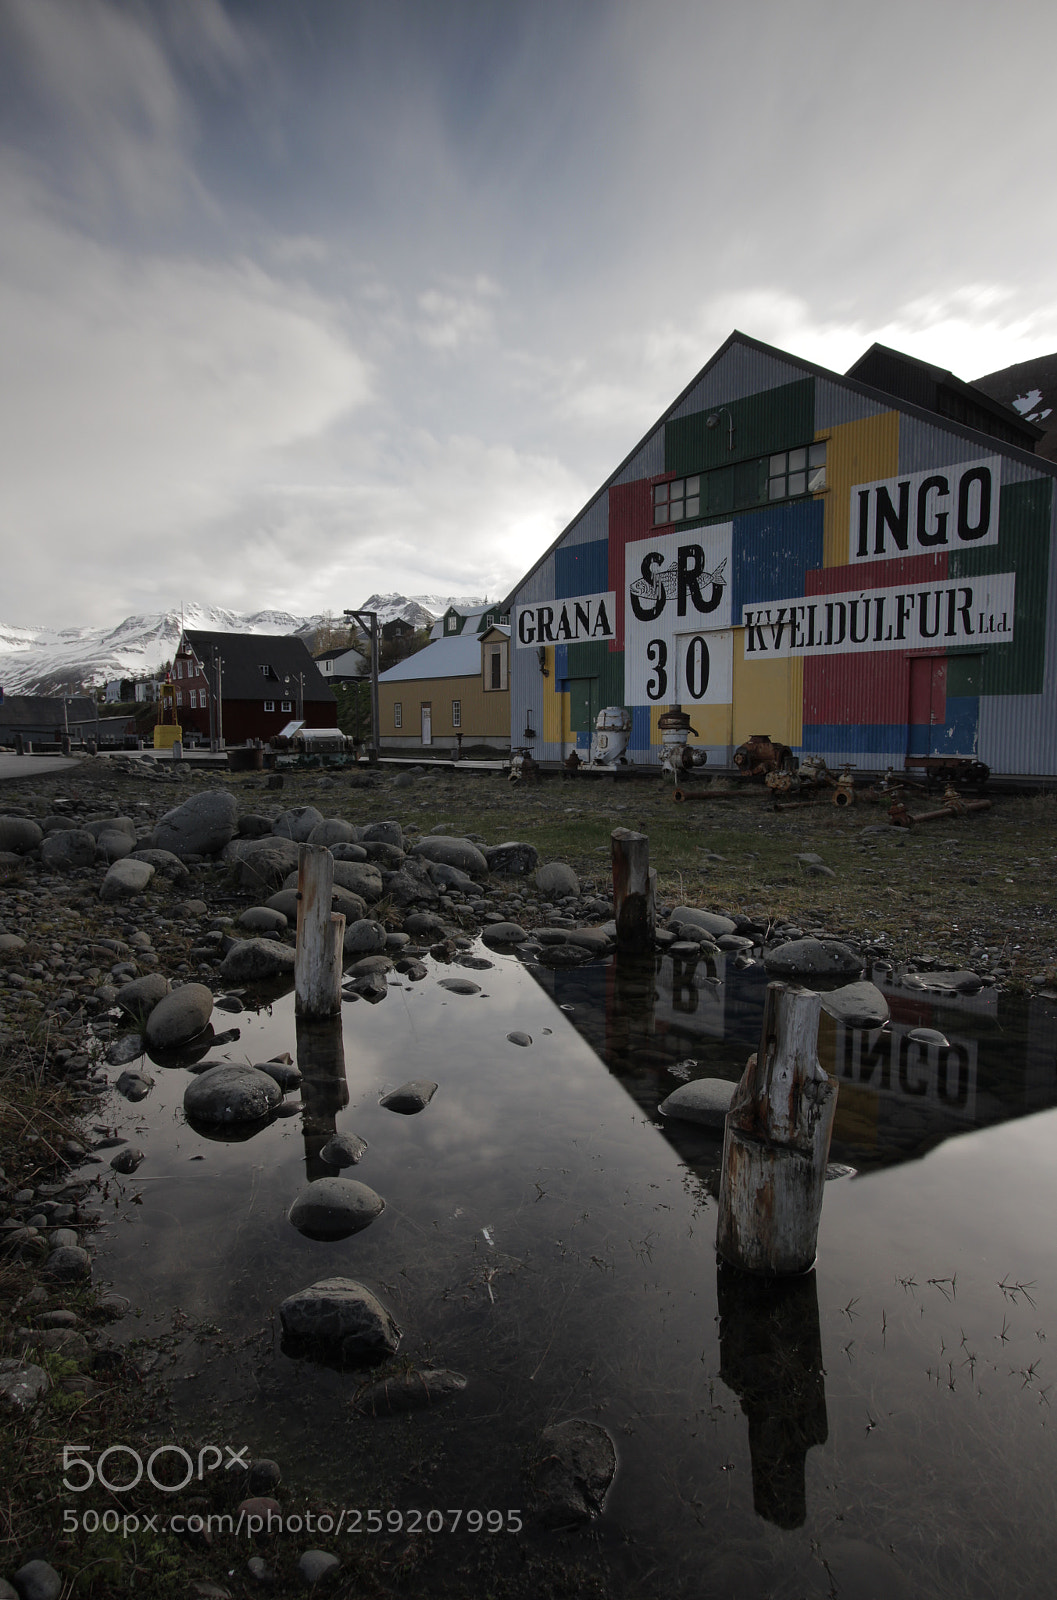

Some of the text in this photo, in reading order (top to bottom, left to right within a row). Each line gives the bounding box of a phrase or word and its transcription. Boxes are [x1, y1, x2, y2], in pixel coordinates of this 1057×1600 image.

[856, 466, 991, 557] INGO
[630, 544, 724, 622] SR
[744, 587, 1011, 652] KVELDÚLFUR Ltd.
